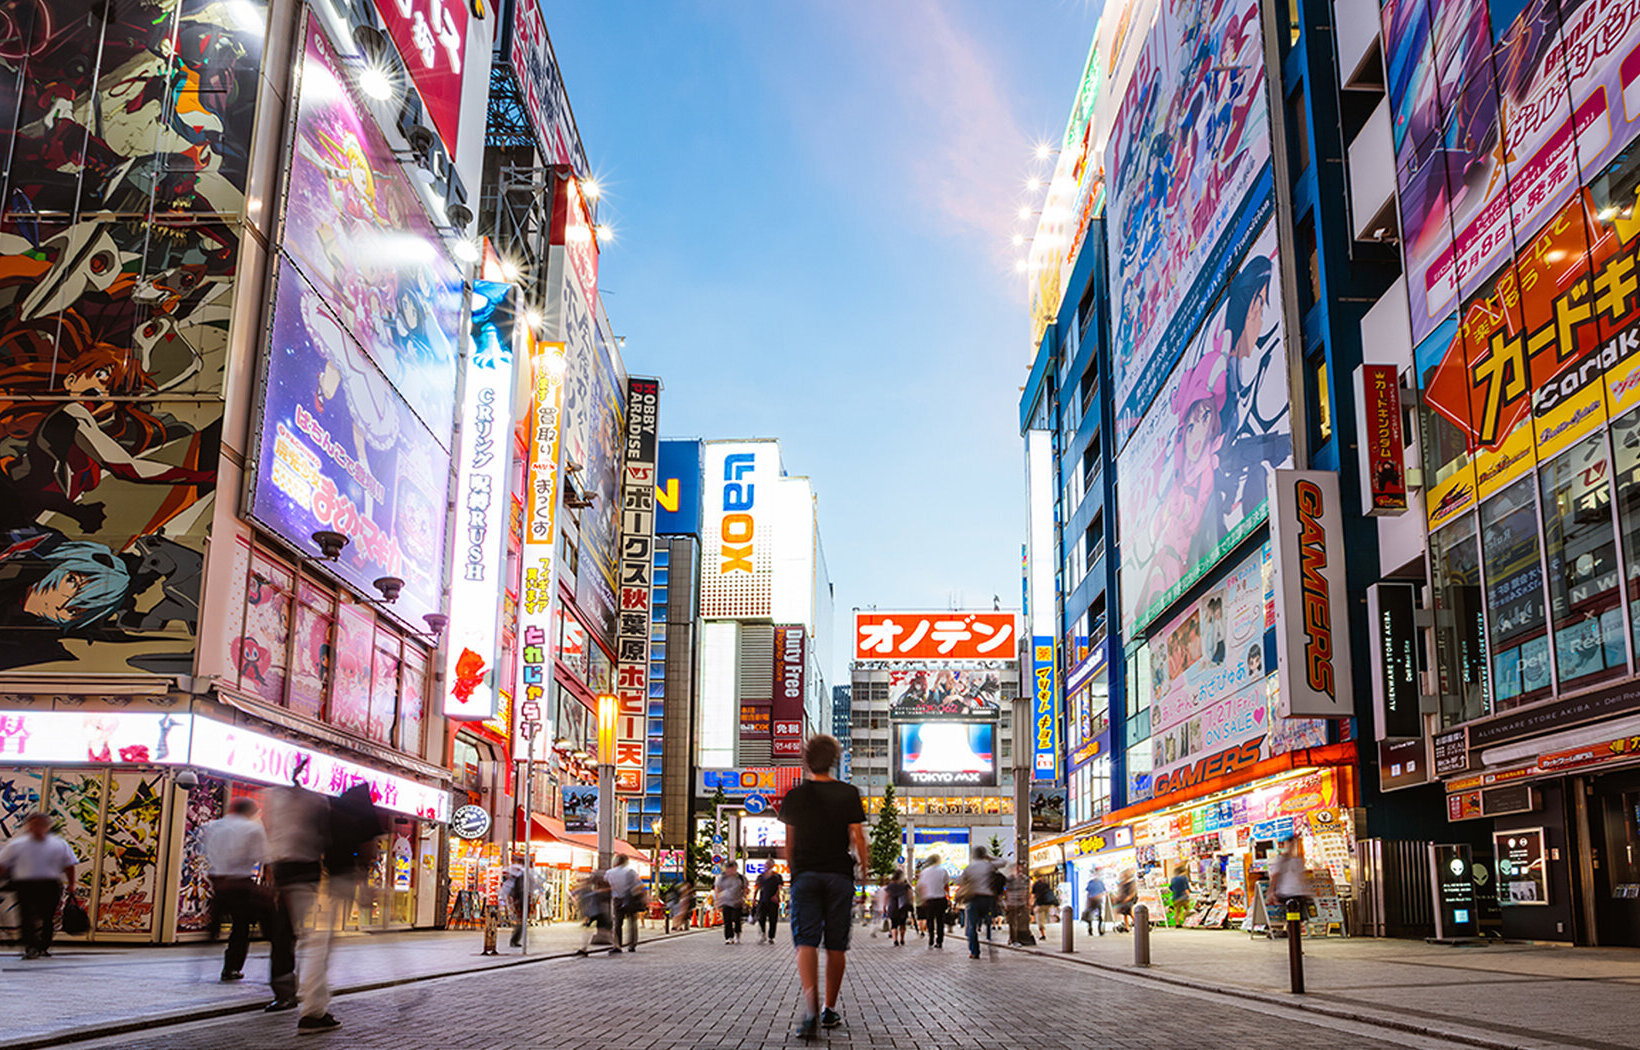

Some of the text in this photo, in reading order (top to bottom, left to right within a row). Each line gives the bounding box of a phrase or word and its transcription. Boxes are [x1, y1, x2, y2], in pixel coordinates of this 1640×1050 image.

[627, 382, 643, 460] PARADISE
[642, 383, 657, 436] HOBBY
[532, 478, 553, 537] まっくす
[1294, 479, 1337, 703] GAMERS
[783, 629, 803, 698] Duty Free
[859, 614, 1013, 654] オノデン
[1528, 711, 1557, 726] STORE
[1560, 702, 1592, 717] AKIBA
[910, 772, 954, 783] TOKYO
[1153, 736, 1266, 799] GAMERS
